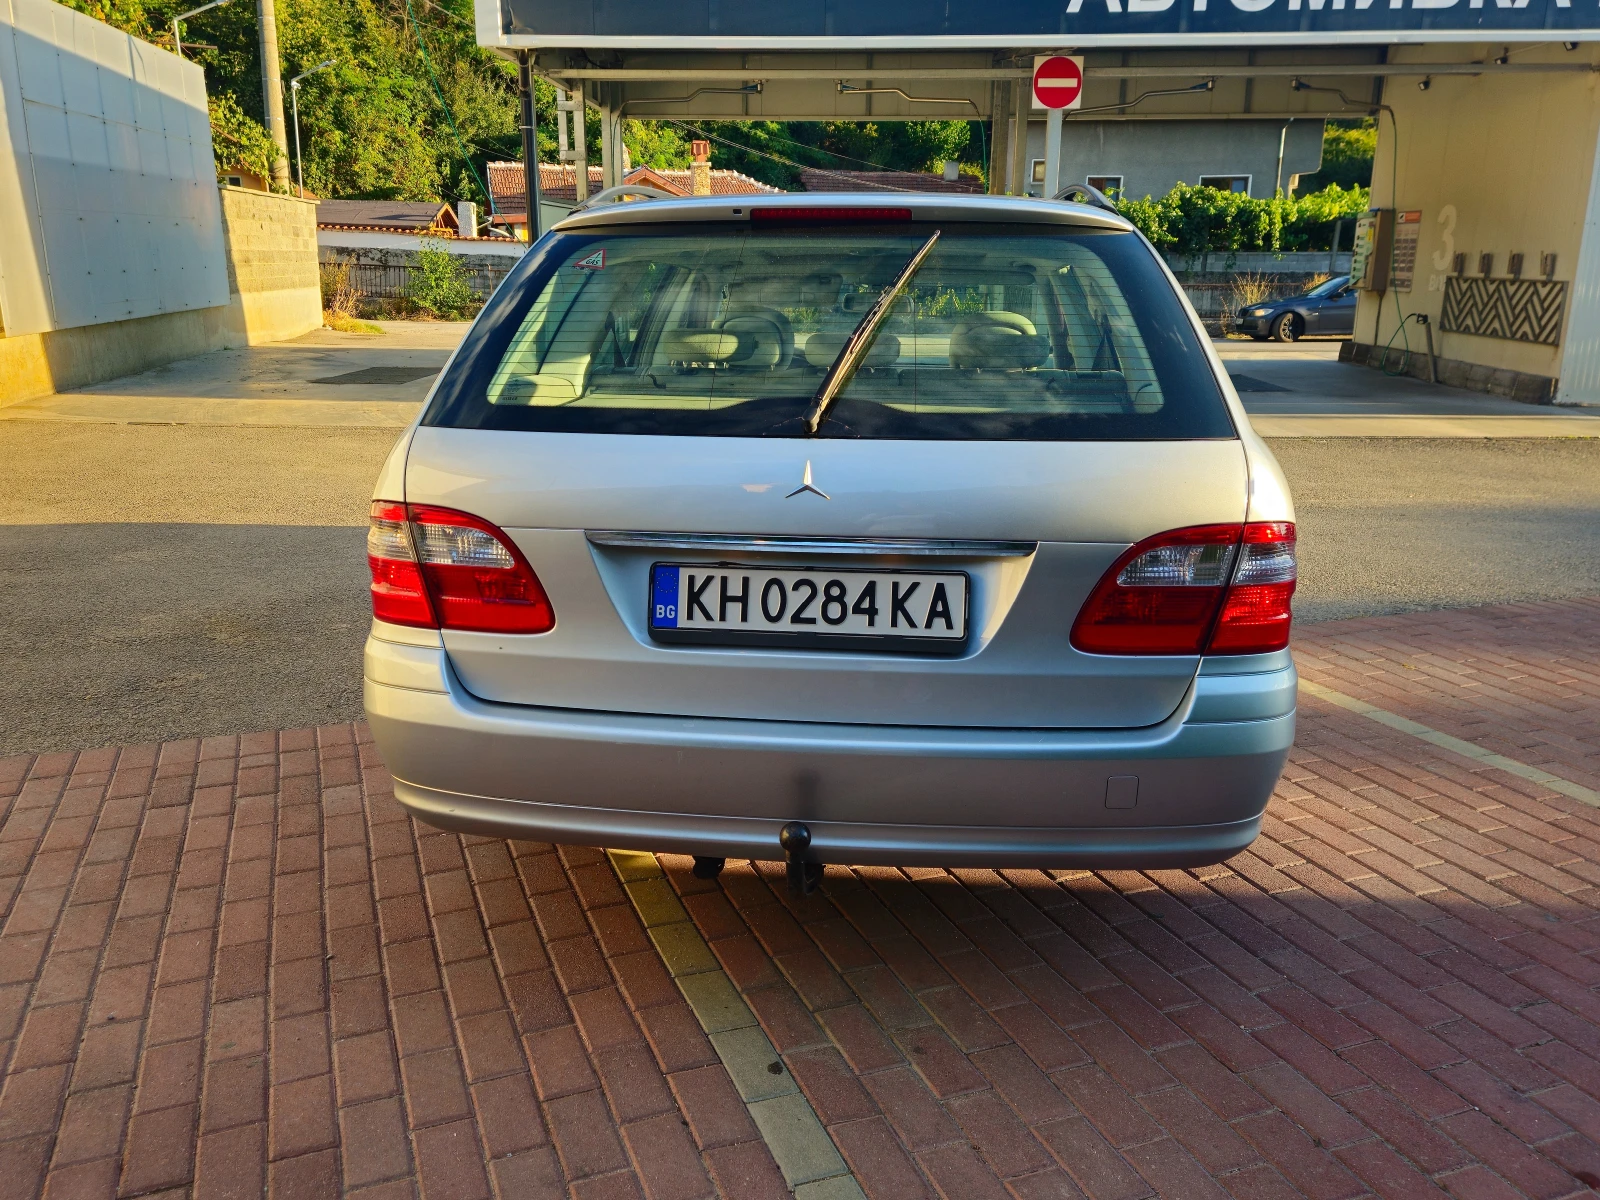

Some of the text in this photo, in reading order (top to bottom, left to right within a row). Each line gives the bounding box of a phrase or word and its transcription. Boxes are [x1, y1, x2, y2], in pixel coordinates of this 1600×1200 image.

[1432, 204, 1457, 271] 3
[656, 604, 676, 619] BG
[686, 574, 954, 630] KH 0284 KA
